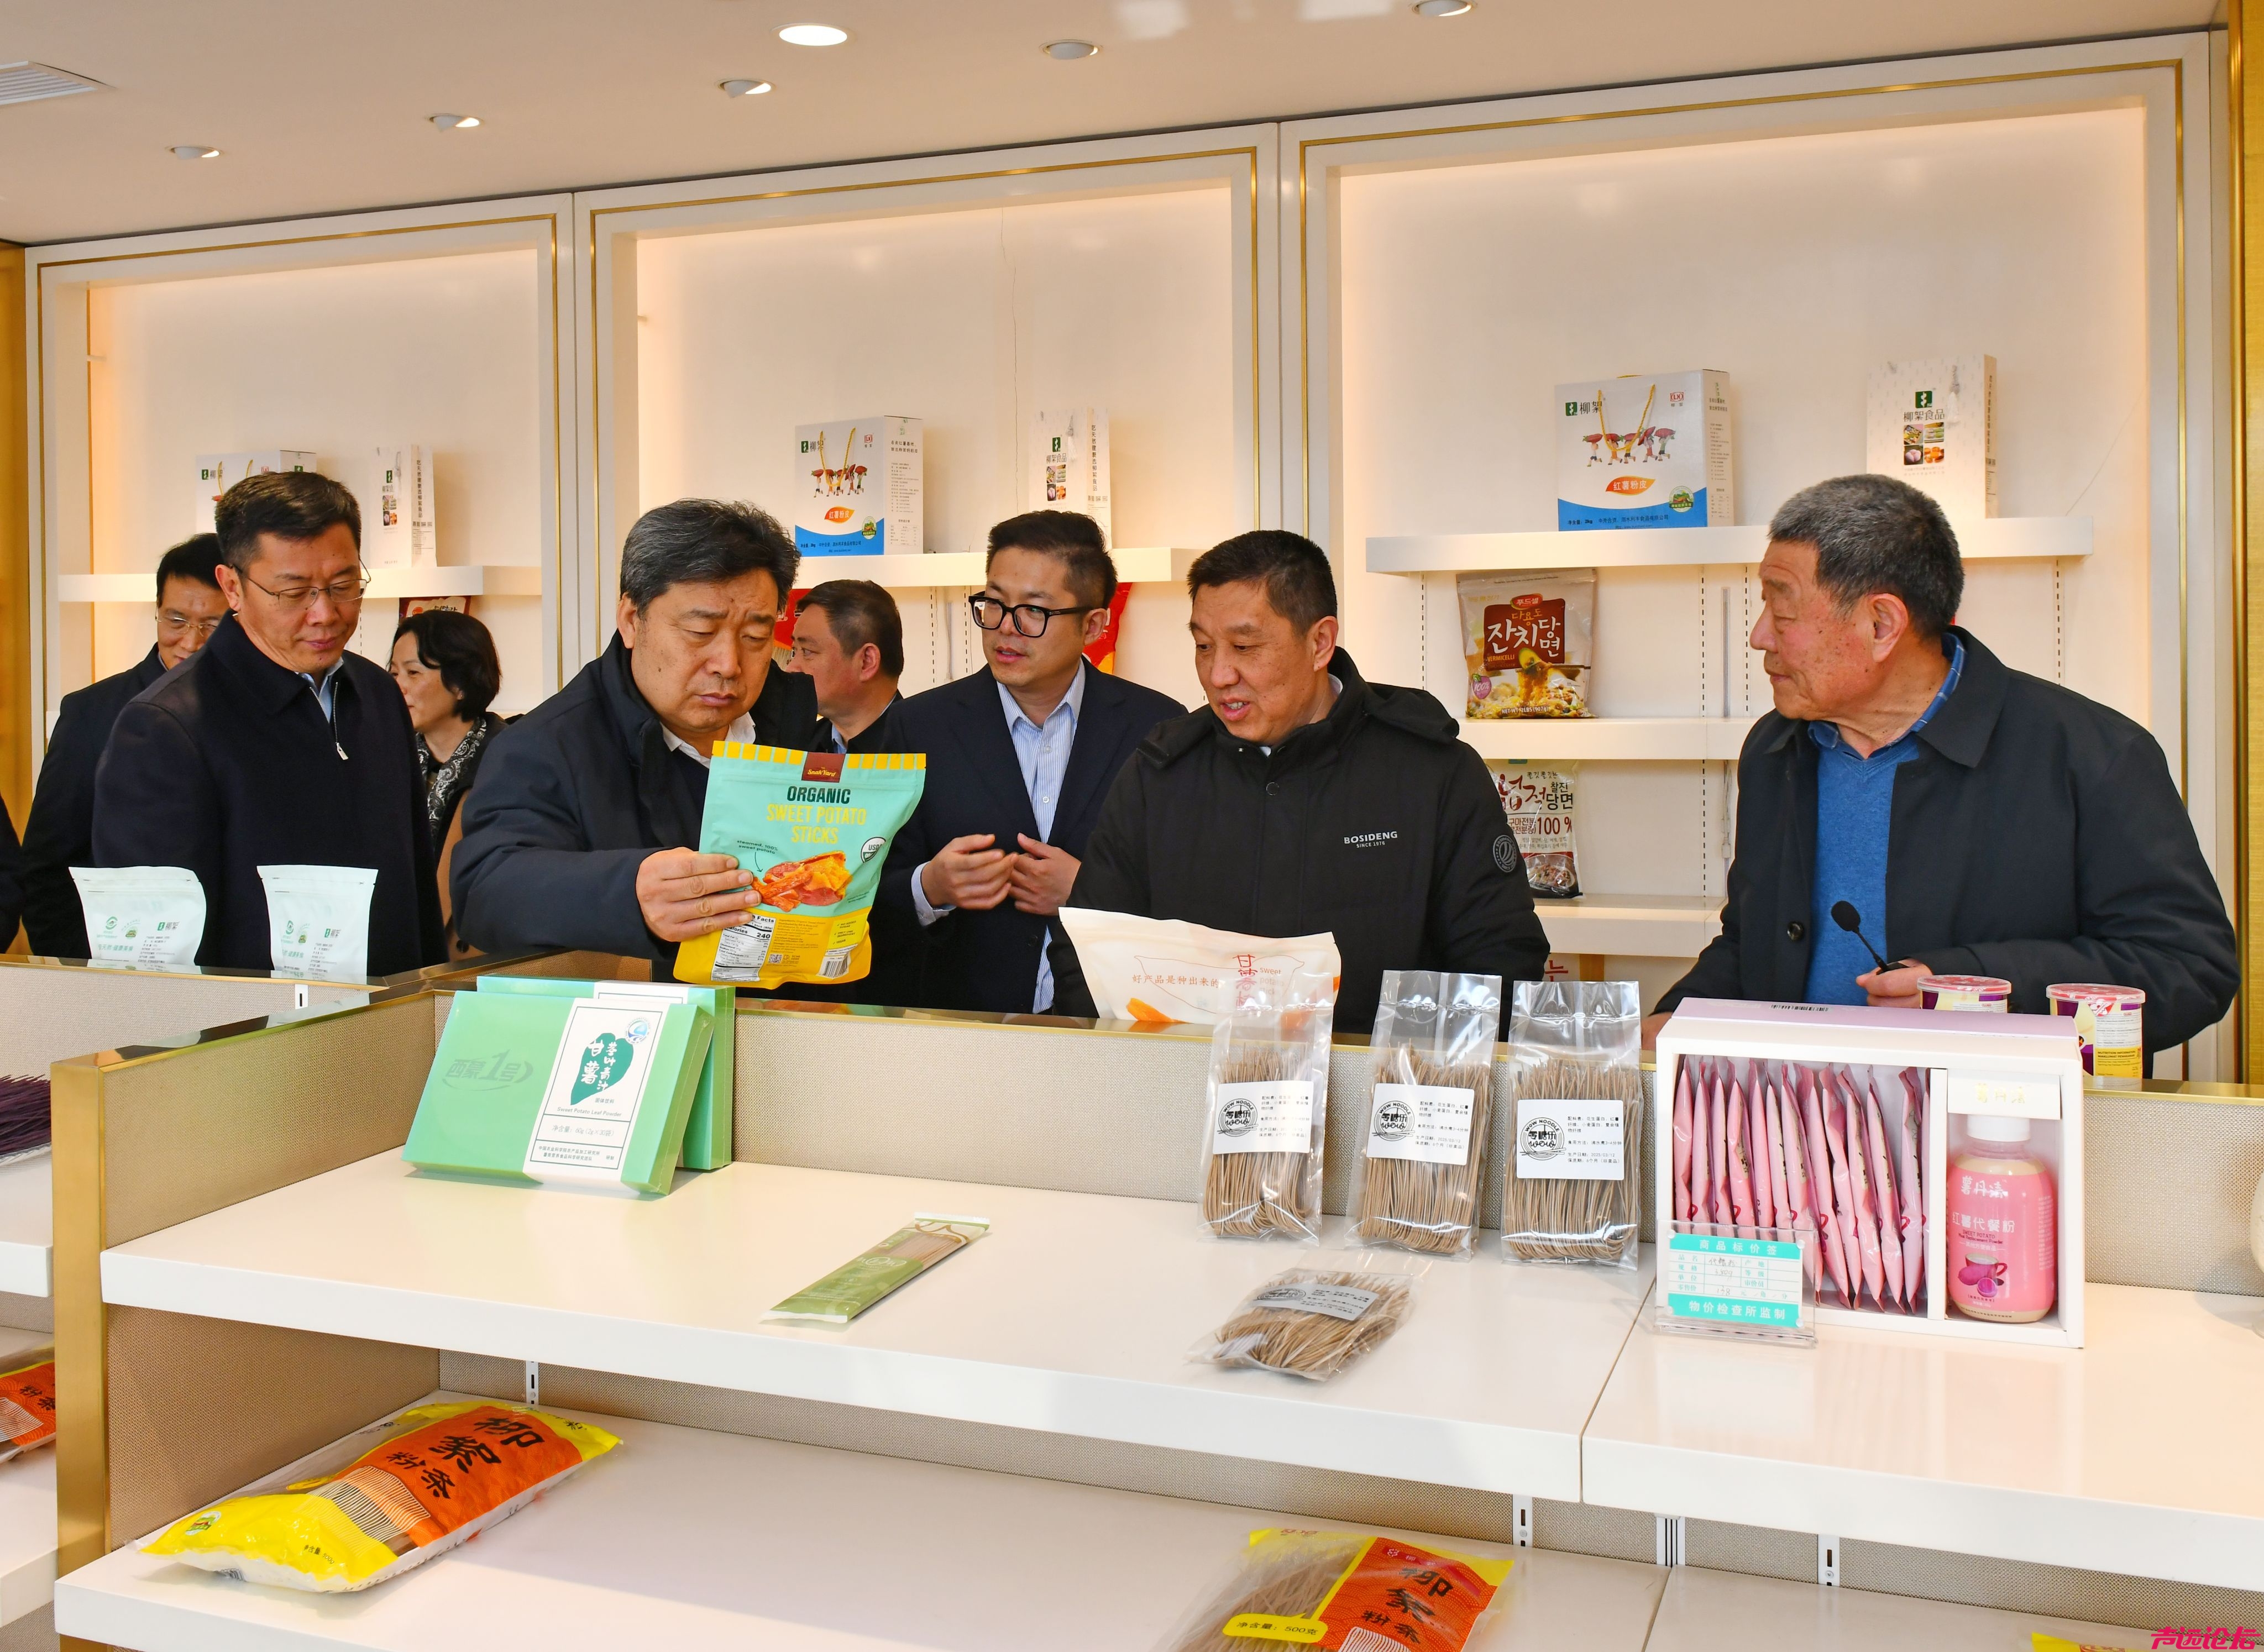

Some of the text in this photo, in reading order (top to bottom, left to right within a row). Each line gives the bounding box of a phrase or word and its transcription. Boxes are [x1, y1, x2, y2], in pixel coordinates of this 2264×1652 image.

[1580, 401, 1602, 414] 柳絮
[1904, 410, 1945, 422] 柳絮食品
[1046, 453, 1067, 463] 柳絮食品
[1613, 481, 1647, 491] 红薯粉皮
[829, 510, 850, 519] 红薯粉皮
[1512, 609, 1543, 626] 다용도
[1550, 782, 1568, 793] 찰진
[787, 786, 850, 804] ORGANIC
[1547, 793, 1573, 810] 당면
[767, 804, 866, 825] SWEET POTATO
[792, 825, 838, 844] STICKS
[1344, 831, 1398, 845] BOSIDENG
[1132, 974, 1219, 989] 好产品是种出来的
[581, 1040, 604, 1084] 甘薯
[1223, 1100, 1254, 1113] WOW NOODLE
[1379, 1103, 1411, 1115] WOW NOODLE
[1525, 1120, 1560, 1132] WOW NOODLE
[1952, 1212, 2015, 1233] 红薯代餐粉
[1700, 1240, 1777, 1255] 商品标价签
[1689, 1300, 1785, 1319] 物价检查所监制
[386, 1451, 455, 1499] 粉条
[322, 1553, 334, 1564] 500g
